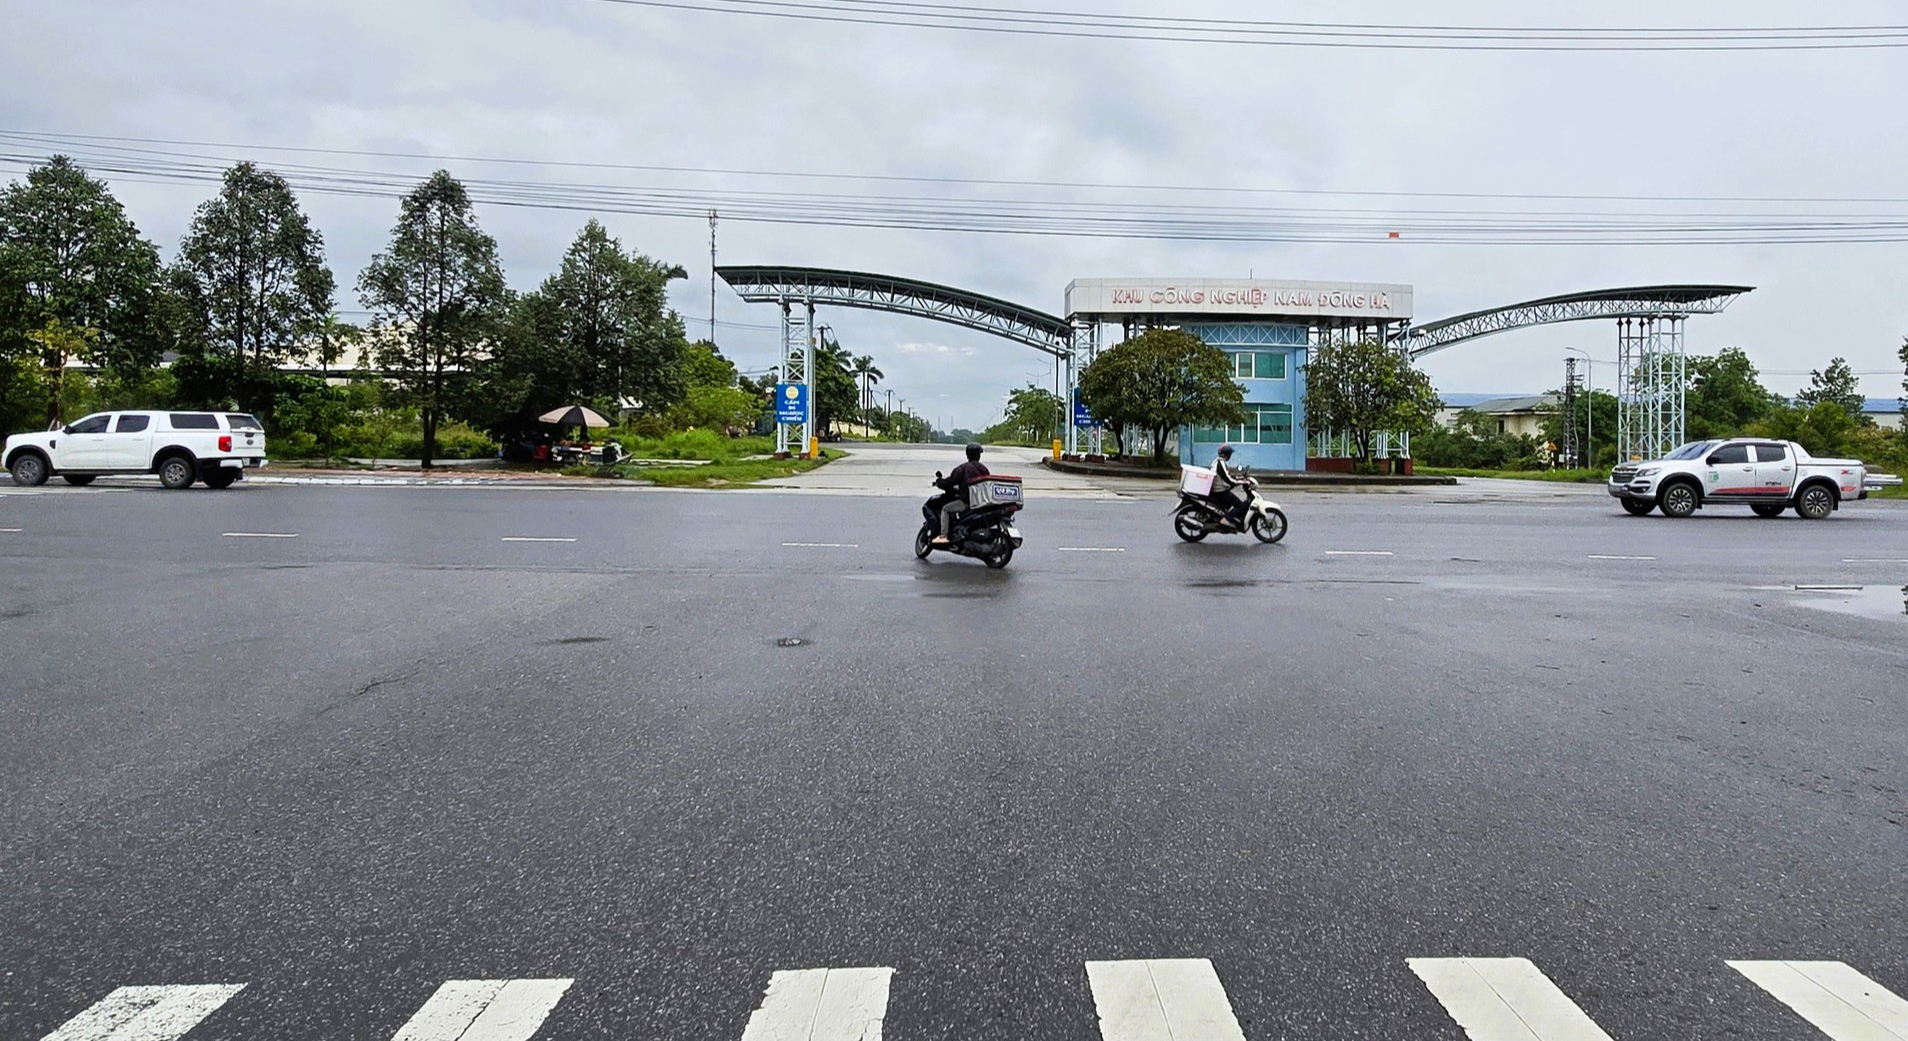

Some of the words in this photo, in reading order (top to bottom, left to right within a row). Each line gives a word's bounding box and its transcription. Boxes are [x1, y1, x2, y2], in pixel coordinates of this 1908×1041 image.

[1112, 289, 1143, 304] KHU
[1150, 287, 1205, 304] CÔNG
[1210, 288, 1269, 308] NGHIỆP
[1274, 291, 1312, 306] NAM
[1318, 291, 1365, 309] ĐÔNG
[1369, 291, 1389, 309] HÀ
